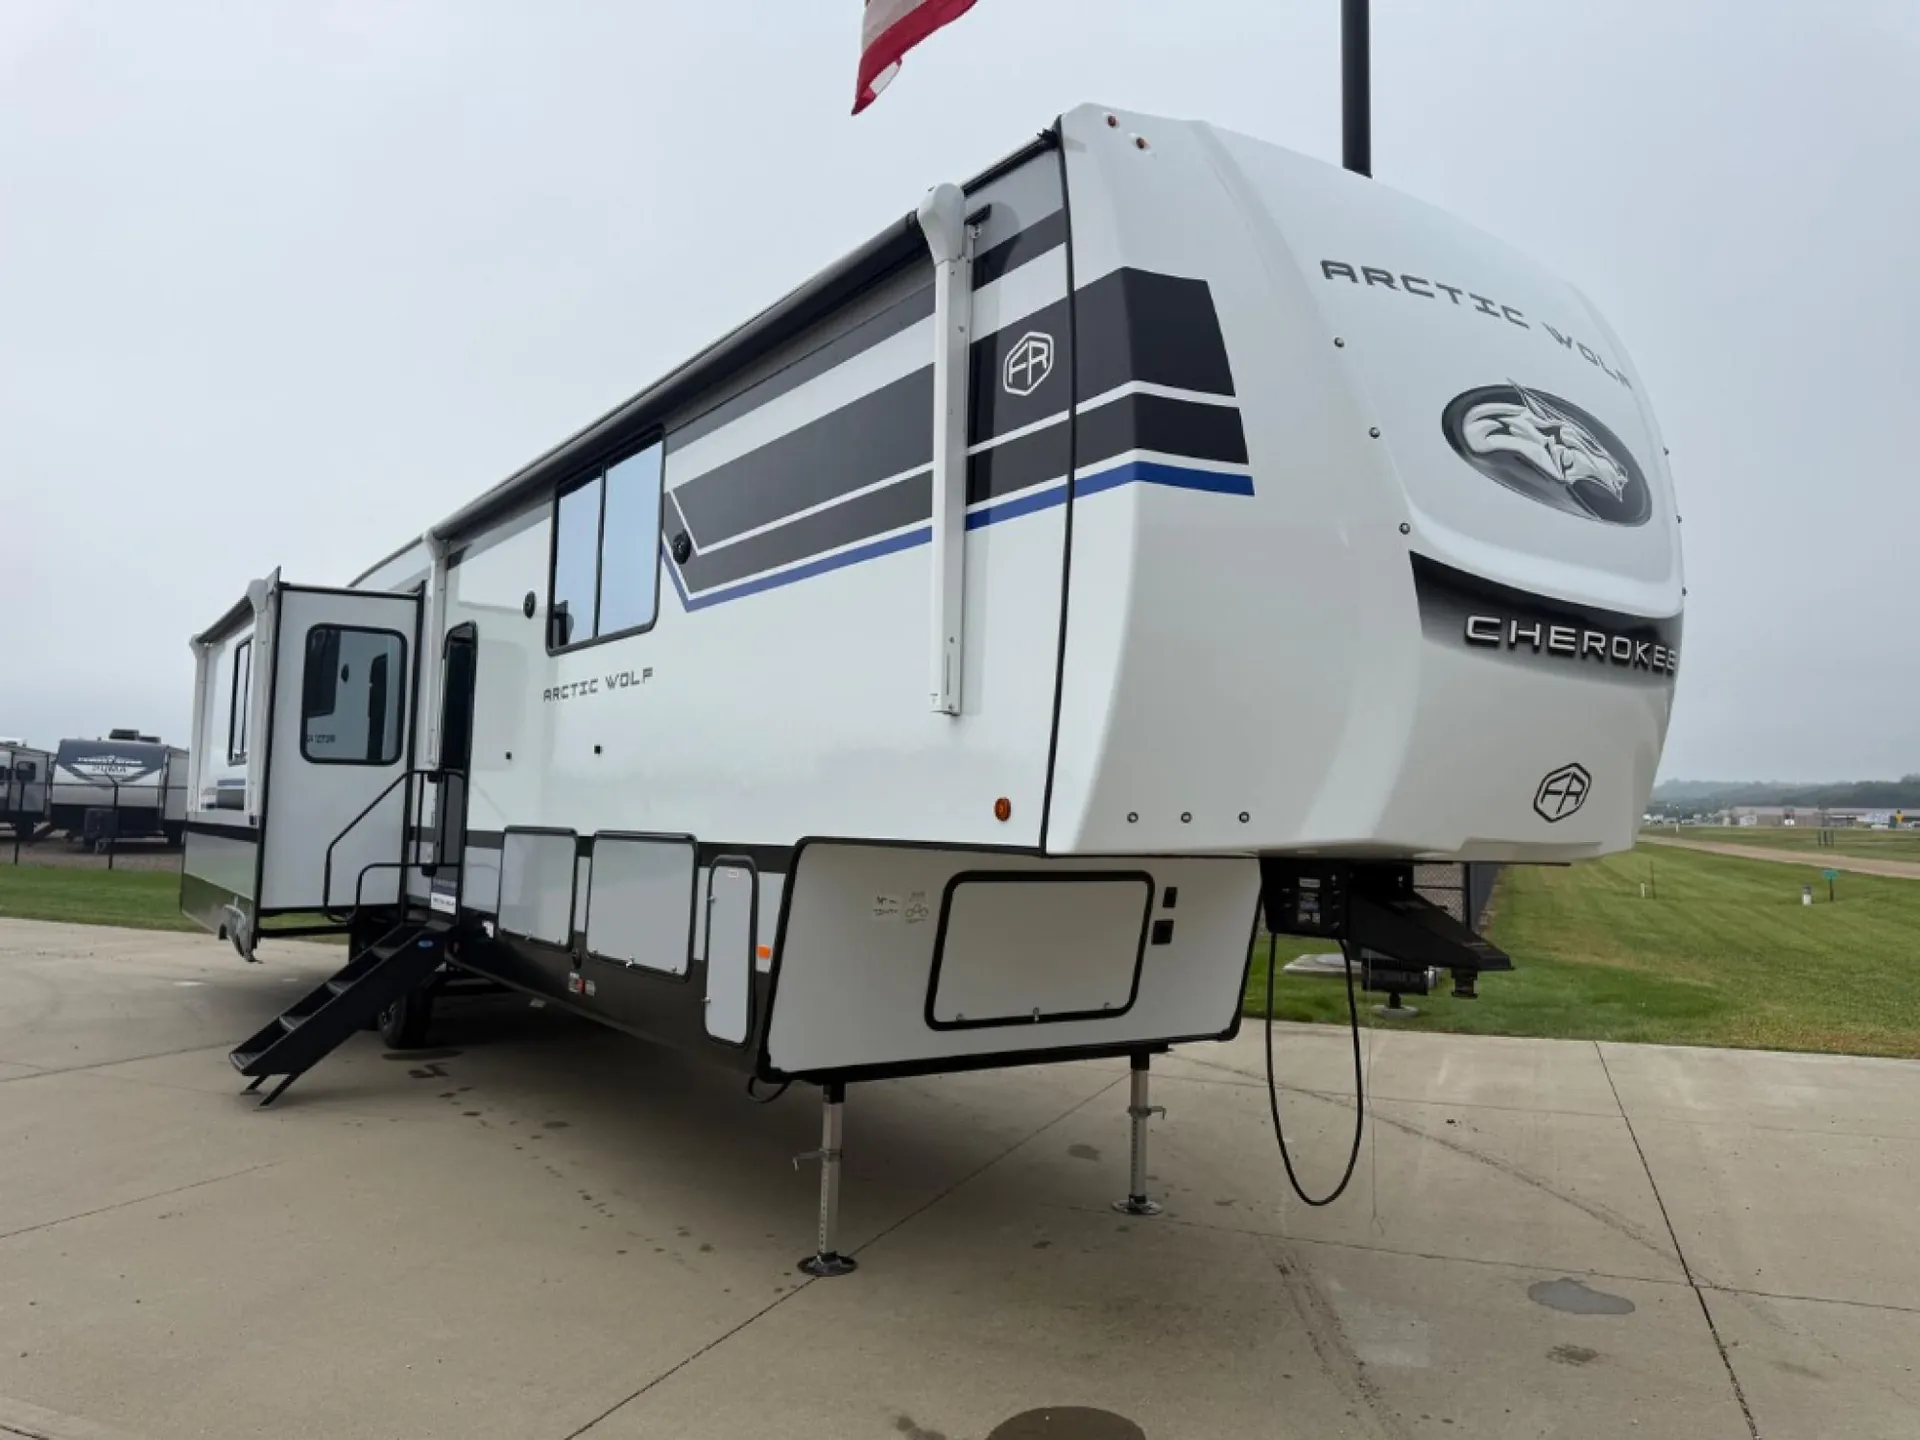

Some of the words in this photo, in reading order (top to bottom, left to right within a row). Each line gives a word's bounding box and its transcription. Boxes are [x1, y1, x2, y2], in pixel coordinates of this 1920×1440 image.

[1319, 259, 1531, 330] ARCTIC
[1467, 615, 1679, 672] CHEROKEE
[543, 679, 599, 702] ARCTIC
[605, 667, 653, 690] WOLF
